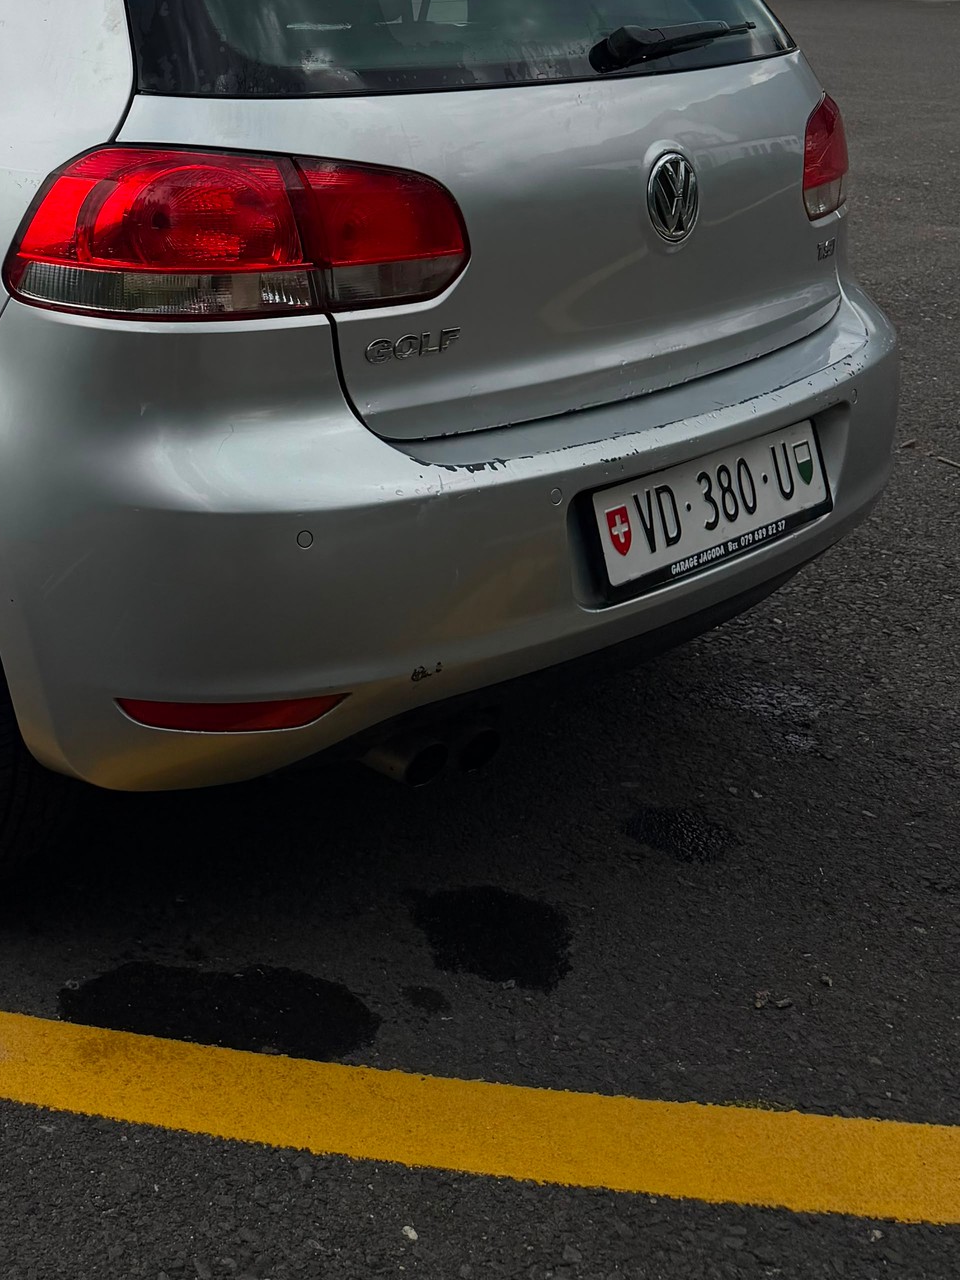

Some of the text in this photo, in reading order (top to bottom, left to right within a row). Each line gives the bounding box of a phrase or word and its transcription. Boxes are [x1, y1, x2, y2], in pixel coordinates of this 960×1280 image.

[365, 326, 460, 364] GOLF
[671, 555, 698, 575] GARAGE
[699, 545, 725, 563] JAGODA
[740, 534, 753, 547] 079
[768, 523, 777, 535] 82
[778, 520, 786, 531] 37
